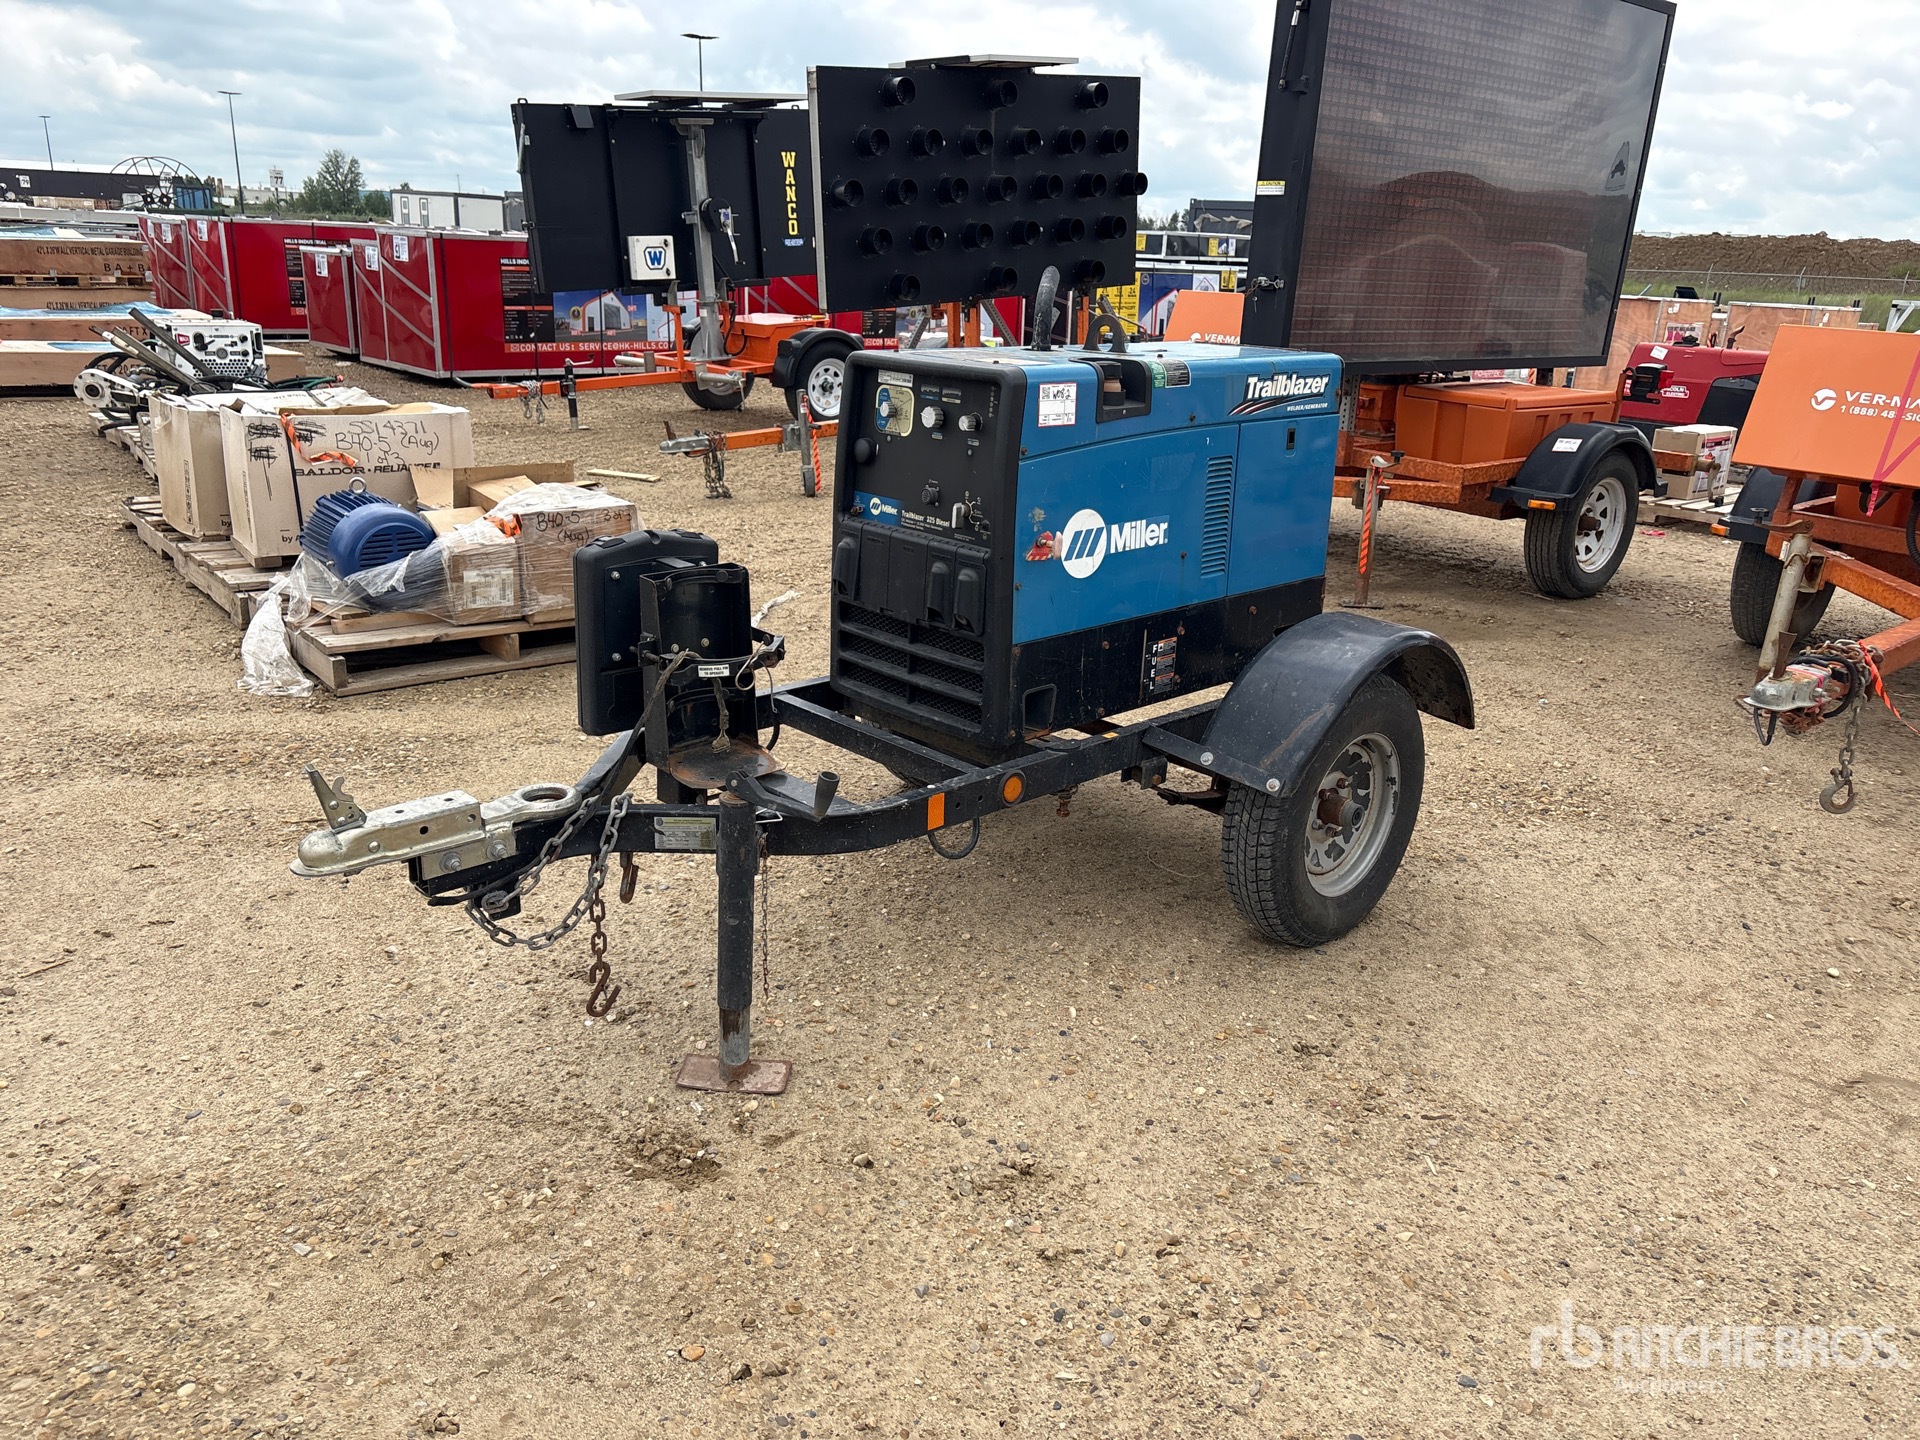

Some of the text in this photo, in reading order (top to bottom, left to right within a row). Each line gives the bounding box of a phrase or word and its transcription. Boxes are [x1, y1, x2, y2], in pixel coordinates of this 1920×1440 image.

[274, 176, 283, 184] 77
[781, 151, 799, 236] WANCO
[647, 250, 663, 266] W
[1246, 373, 1330, 399] Trailblazer
[1286, 402, 1328, 412] WELDER/GENERATOR
[1849, 406, 1878, 416] (888)
[296, 466, 366, 476] BALDOR
[882, 504, 898, 516] Miller
[902, 510, 924, 522] Trailblazer
[926, 516, 936, 524] 325
[936, 518, 950, 528] Diesel
[281, 535, 293, 544] by
[1110, 519, 1168, 554] Miller
